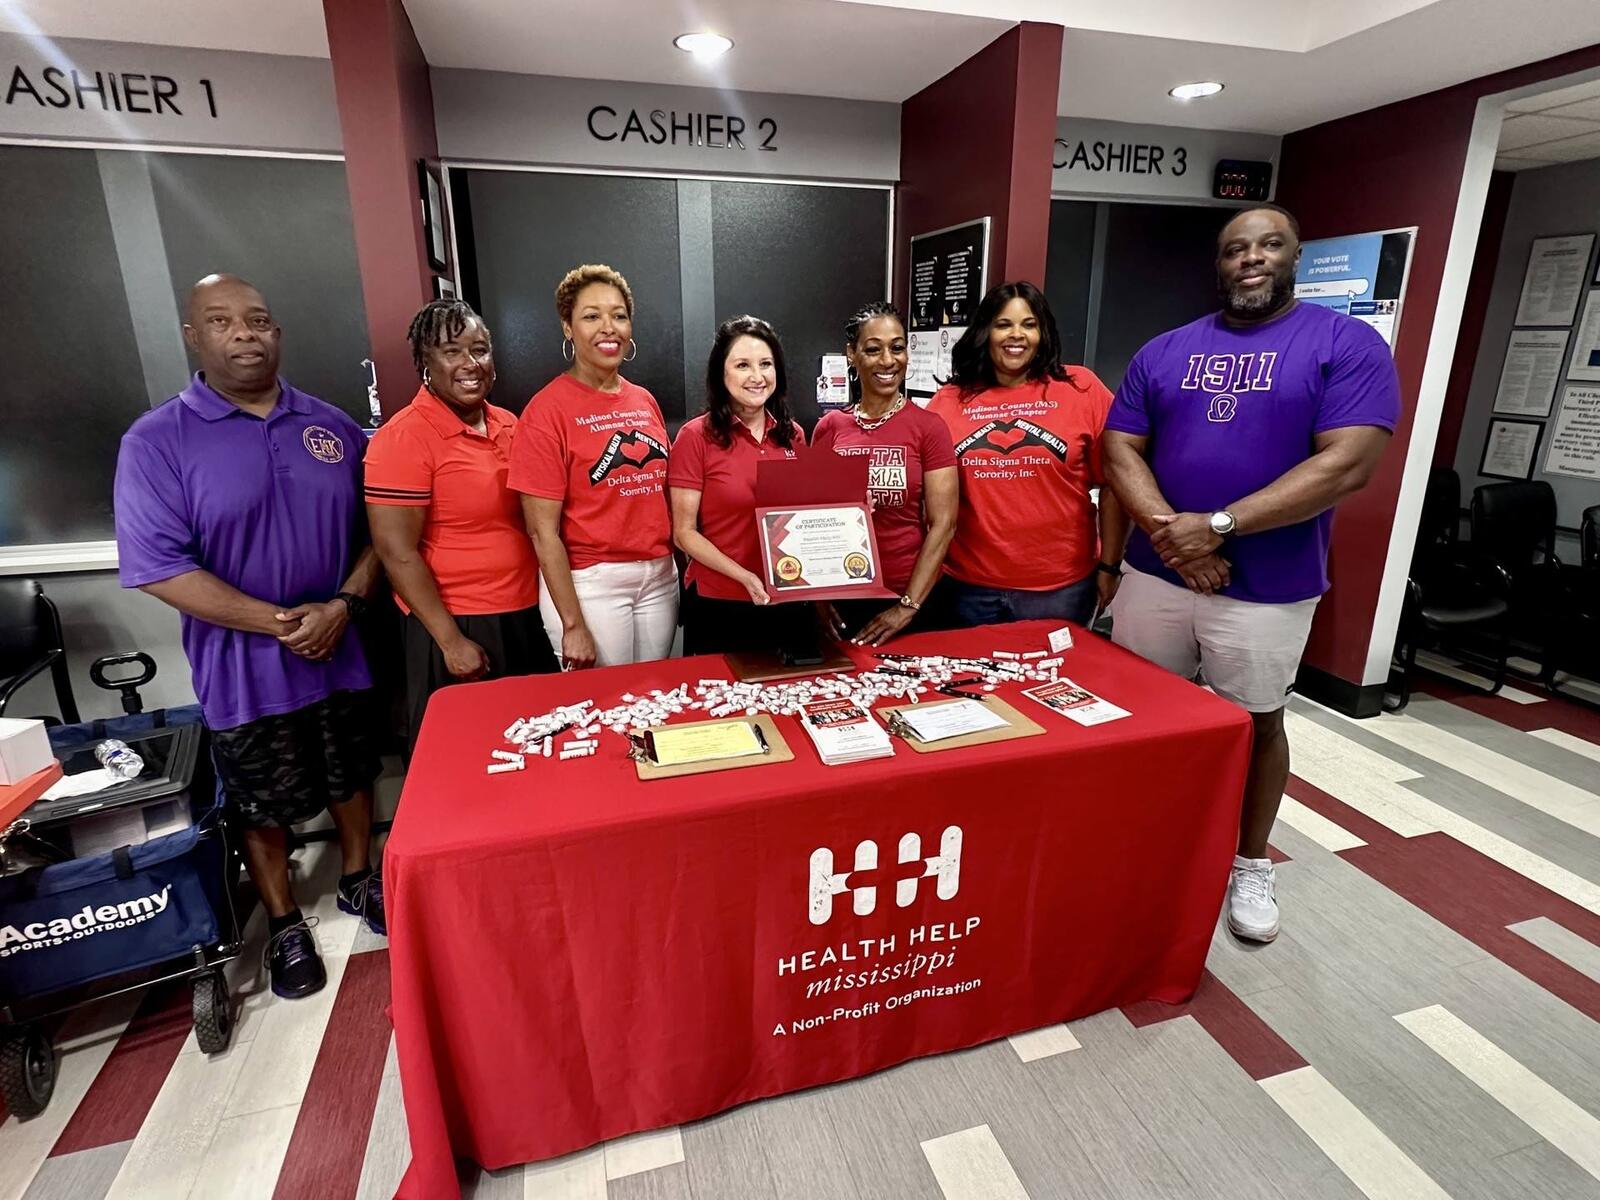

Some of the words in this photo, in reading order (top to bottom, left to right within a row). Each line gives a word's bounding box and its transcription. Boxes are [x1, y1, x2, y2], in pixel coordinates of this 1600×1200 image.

[5, 65, 183, 116] ASHIER
[199, 79, 218, 118] 1
[587, 105, 746, 150] CASHIER
[758, 117, 778, 151] 2
[1171, 147, 1188, 177] 3
[1313, 257, 1331, 265] YOUR
[1331, 254, 1350, 263] VOTE
[1181, 352, 1278, 393] 1911
[575, 412, 612, 426] Madison
[962, 406, 998, 415] Madison
[1000, 402, 1033, 411] County
[969, 411, 1008, 421] Alumnae
[1010, 409, 1047, 417] Chapter
[590, 421, 625, 433] Alumnae
[974, 422, 997, 440] HEALTH
[1014, 419, 1041, 437] MENTAL
[1040, 430, 1067, 454] HEALTH
[635, 431, 660, 450] MENTAL
[591, 453, 614, 481] PHYSICAL
[962, 457, 988, 466] Delta
[990, 456, 1020, 468] Sigma
[1022, 456, 1050, 465] Theta
[974, 469, 1017, 479] Sorority,
[1019, 468, 1037, 477] Inc.
[607, 474, 631, 487] Delta
[632, 473, 654, 483] Sigma
[0, 886, 169, 949] Academy
[778, 934, 896, 976] HEALTH
[909, 916, 981, 946] HELP
[806, 946, 956, 999] mississippi
[773, 1023, 786, 1036] A
[792, 1001, 880, 1034] Non-Profit
[885, 978, 982, 1010] Organization
